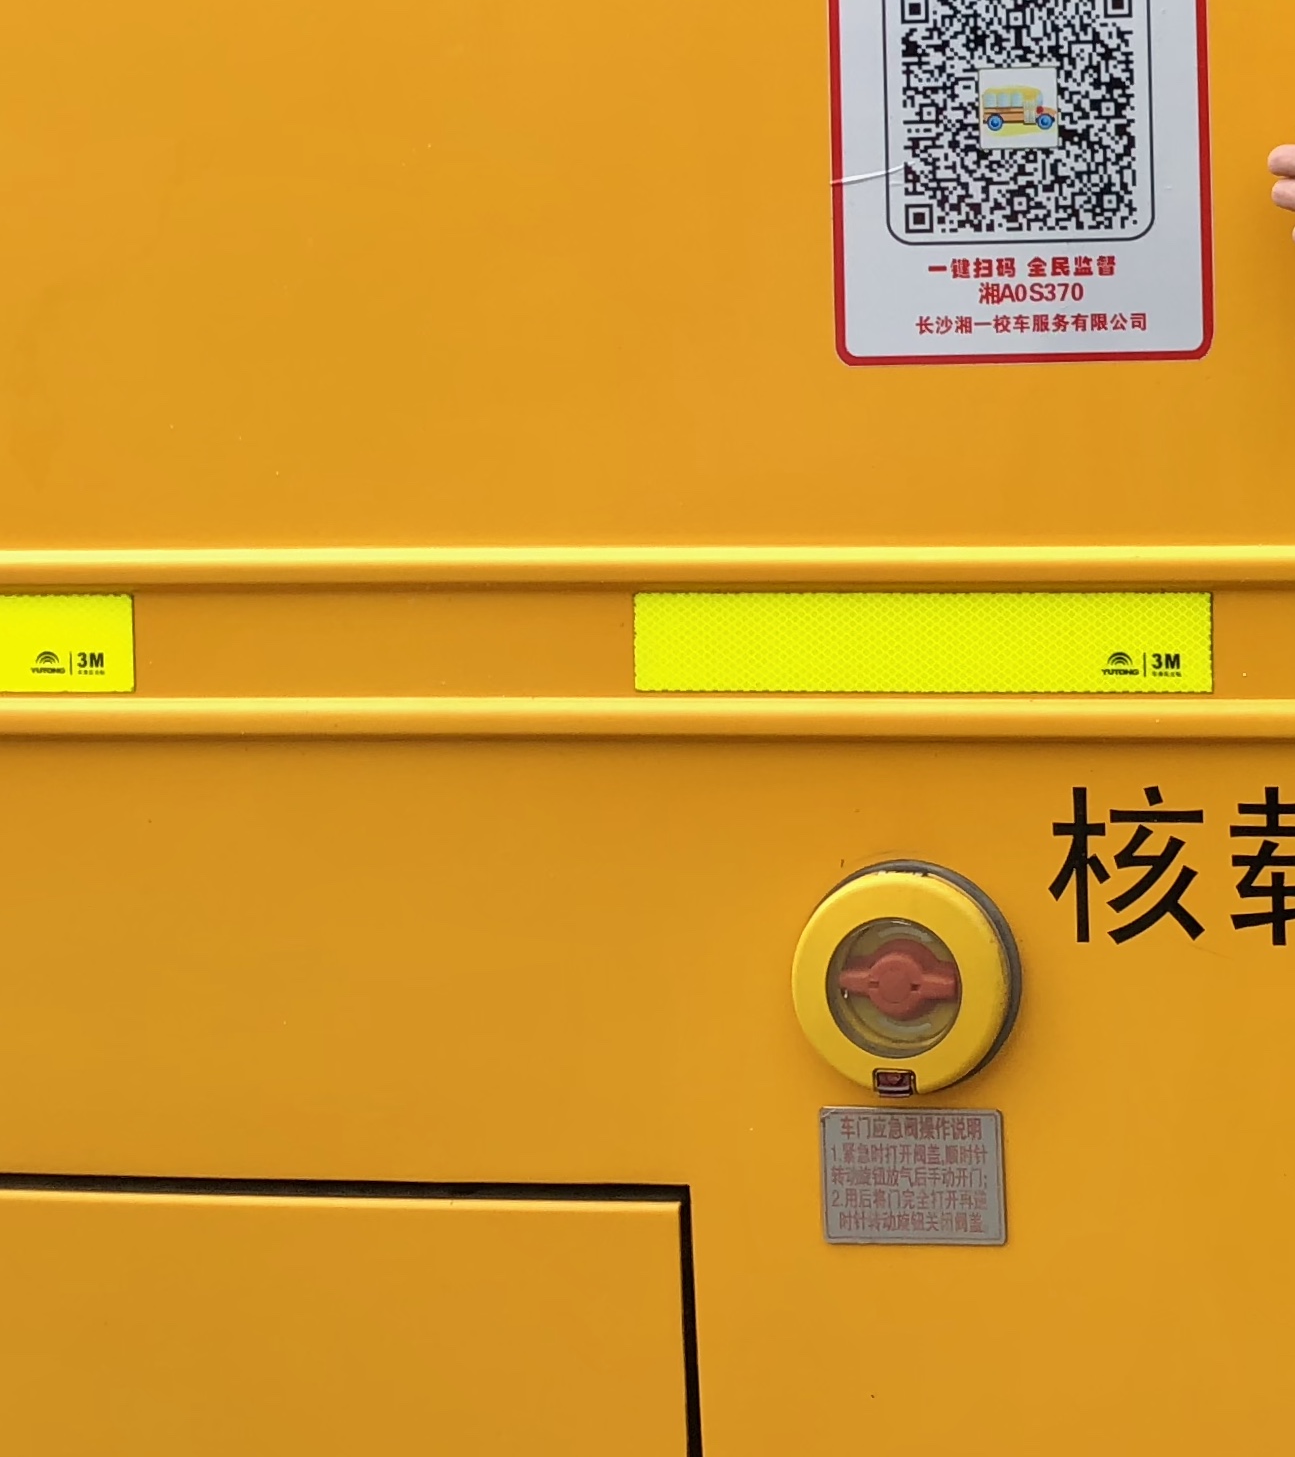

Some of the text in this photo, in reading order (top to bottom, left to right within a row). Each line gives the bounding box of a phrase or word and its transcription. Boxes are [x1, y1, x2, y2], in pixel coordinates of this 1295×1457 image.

[928, 255, 1116, 280] 一键扫码 全民监督
[916, 312, 1148, 335] 长沙湘一校车服务有限公司
[77, 652, 104, 669] 3M
[1151, 652, 1180, 670] 3M
[841, 1116, 982, 1140] 车门应急阀操作说明
